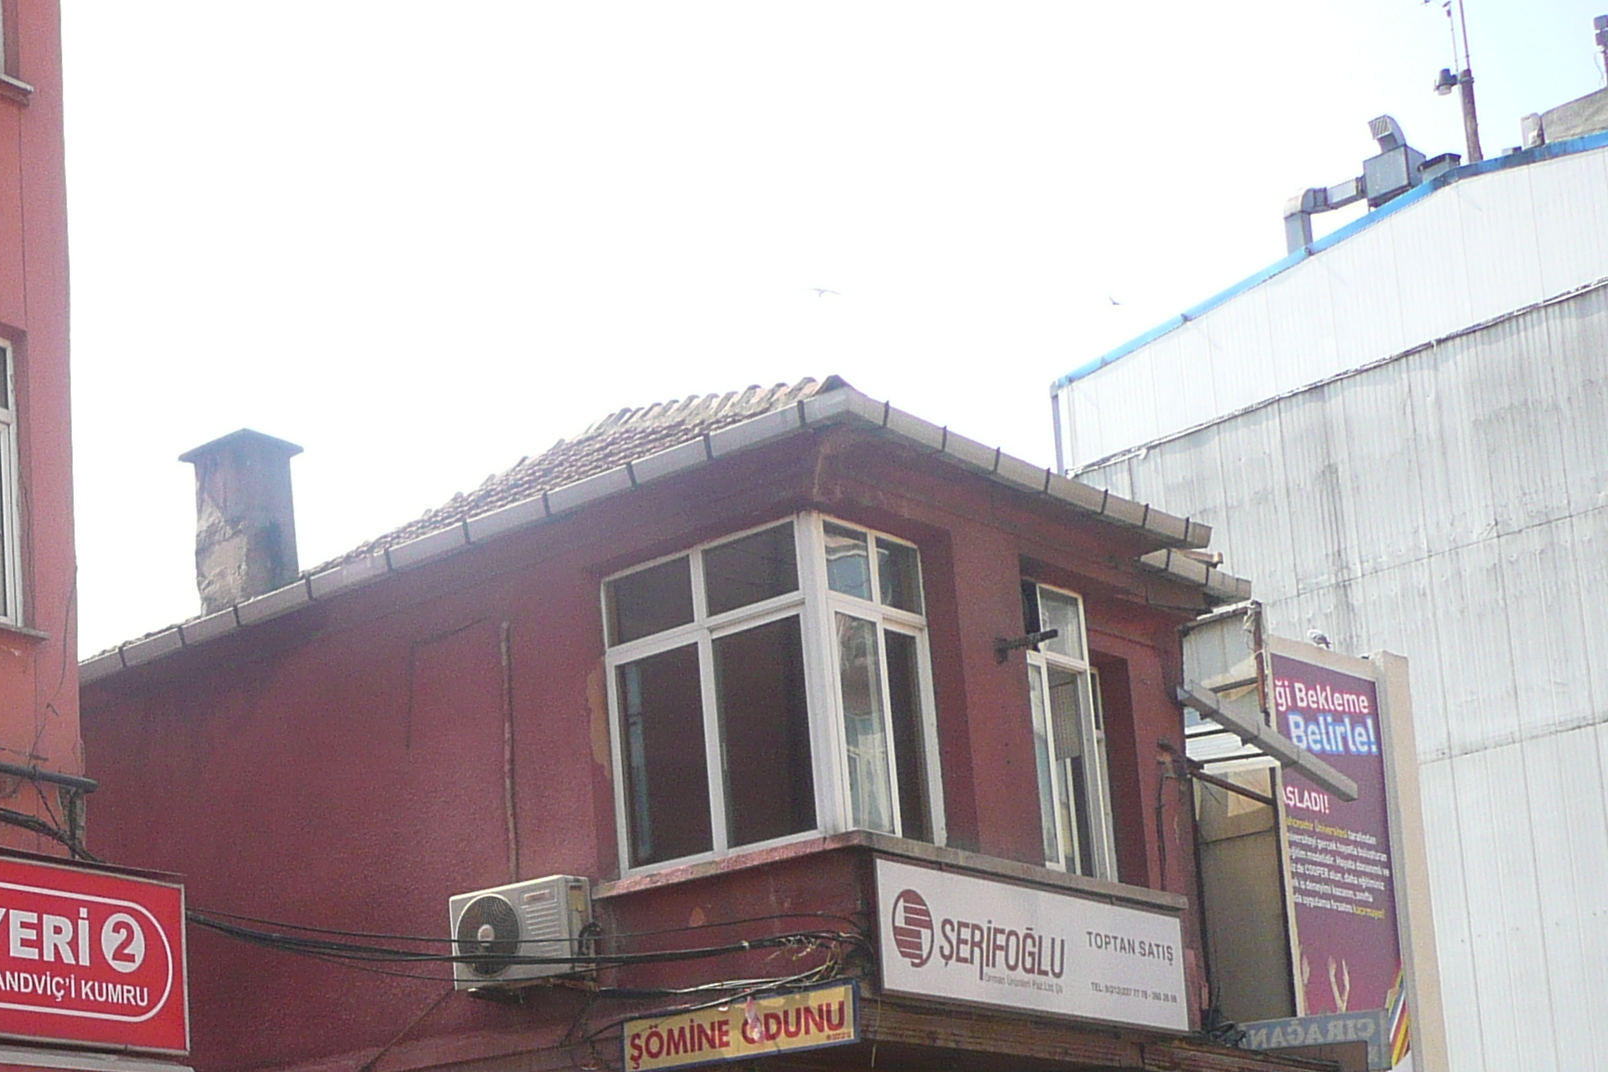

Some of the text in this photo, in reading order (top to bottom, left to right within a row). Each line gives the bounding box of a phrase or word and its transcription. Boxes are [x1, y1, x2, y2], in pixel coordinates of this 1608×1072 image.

[1294, 682, 1369, 714] Bekleme
[1288, 714, 1378, 753] Belirle!
[111, 919, 137, 965] 2
[939, 918, 1065, 981] ŞERİFOĞLU
[1086, 931, 1174, 966] TOPTAN SATIŞ
[81, 979, 149, 1007] KUMRU
[630, 1019, 730, 1070] ŞÖMİNE
